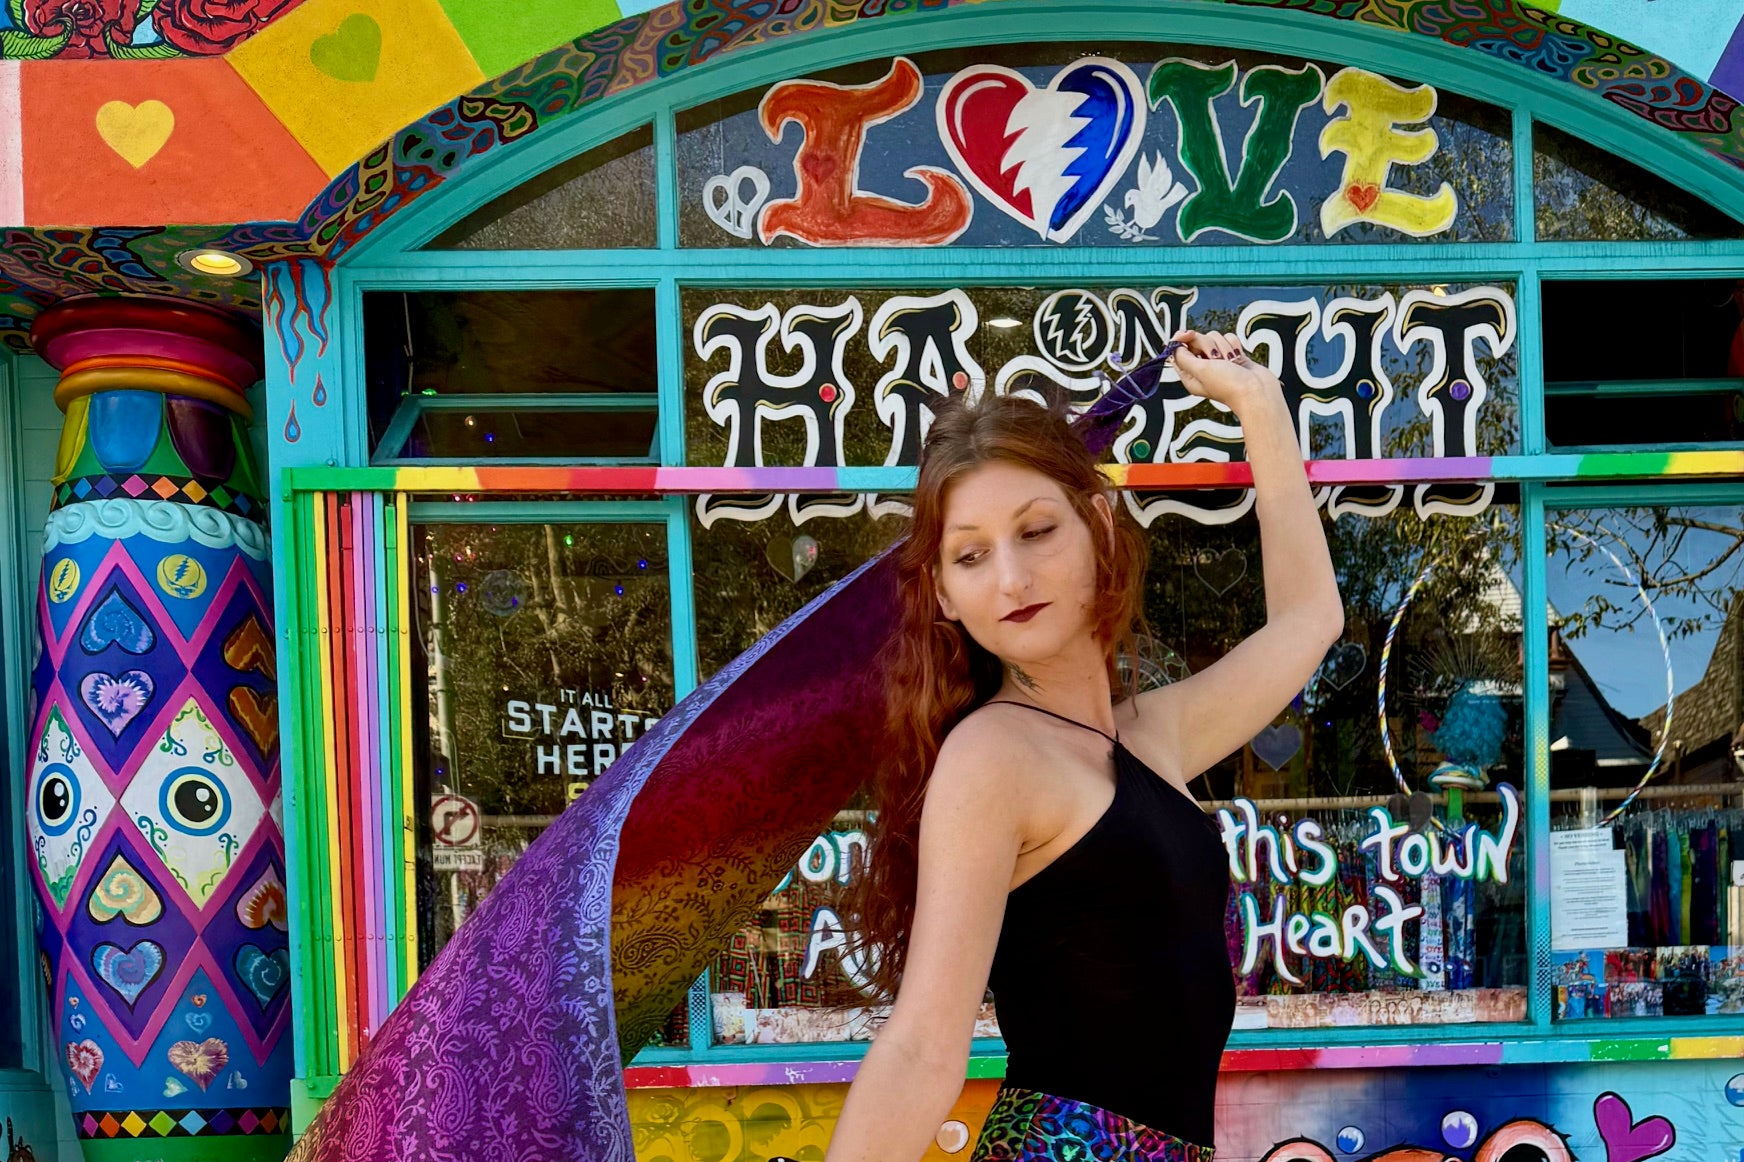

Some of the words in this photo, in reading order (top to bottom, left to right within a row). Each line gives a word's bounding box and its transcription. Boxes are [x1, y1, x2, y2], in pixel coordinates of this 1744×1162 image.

[1033, 286, 1199, 372] ON
[560, 688, 576, 704] IT
[582, 691, 613, 709] ALL
